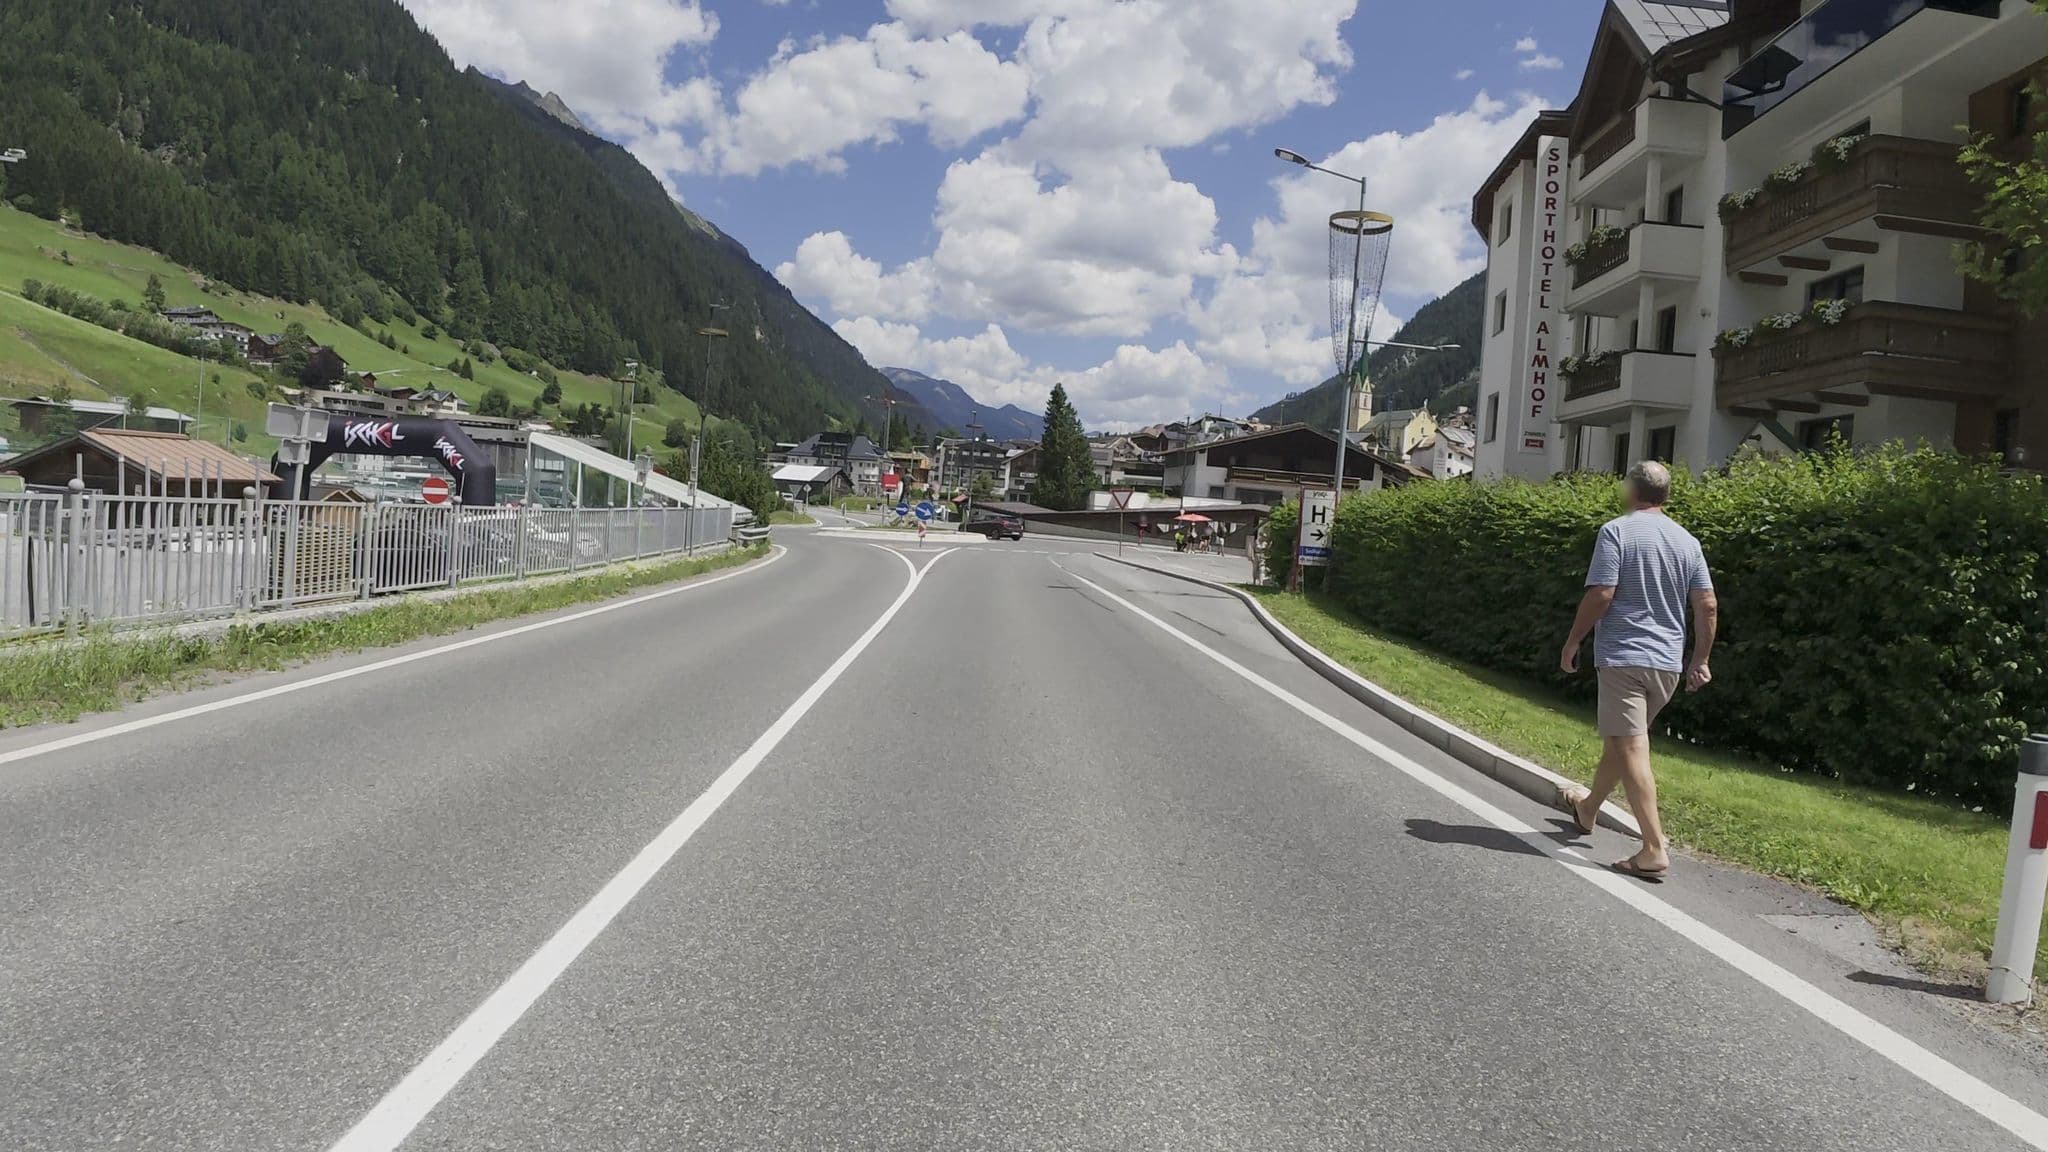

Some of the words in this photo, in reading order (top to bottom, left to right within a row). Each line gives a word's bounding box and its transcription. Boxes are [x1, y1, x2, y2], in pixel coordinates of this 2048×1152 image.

[1540, 147, 1560, 309] SPORTHOTEL
[1531, 320, 1550, 418] ALMHOF
[1311, 504, 1326, 524] H
